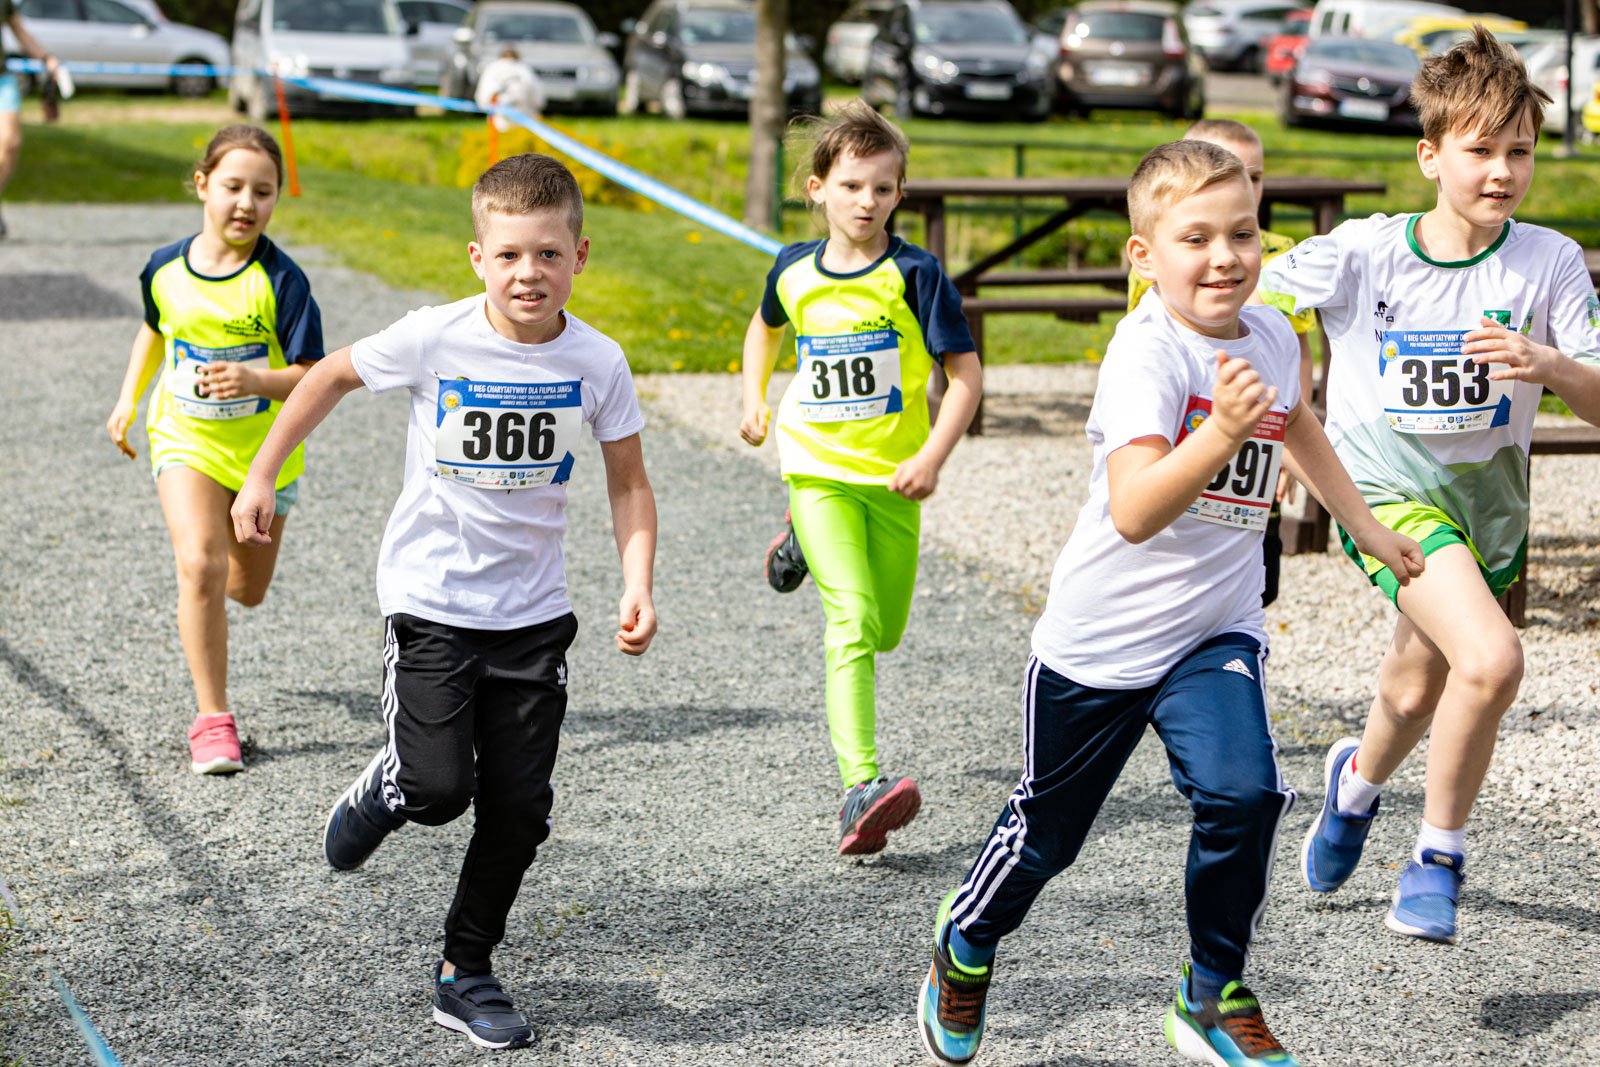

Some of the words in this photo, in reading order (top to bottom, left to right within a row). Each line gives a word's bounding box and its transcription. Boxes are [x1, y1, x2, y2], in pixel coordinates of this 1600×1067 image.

[473, 384, 486, 393] BIEG
[487, 385, 528, 394] CHARYTATYWNY
[528, 386, 538, 394] DLA
[539, 386, 556, 394] FILIPKA
[812, 357, 876, 399] 318
[1402, 358, 1490, 407] 353
[463, 411, 556, 462] 366
